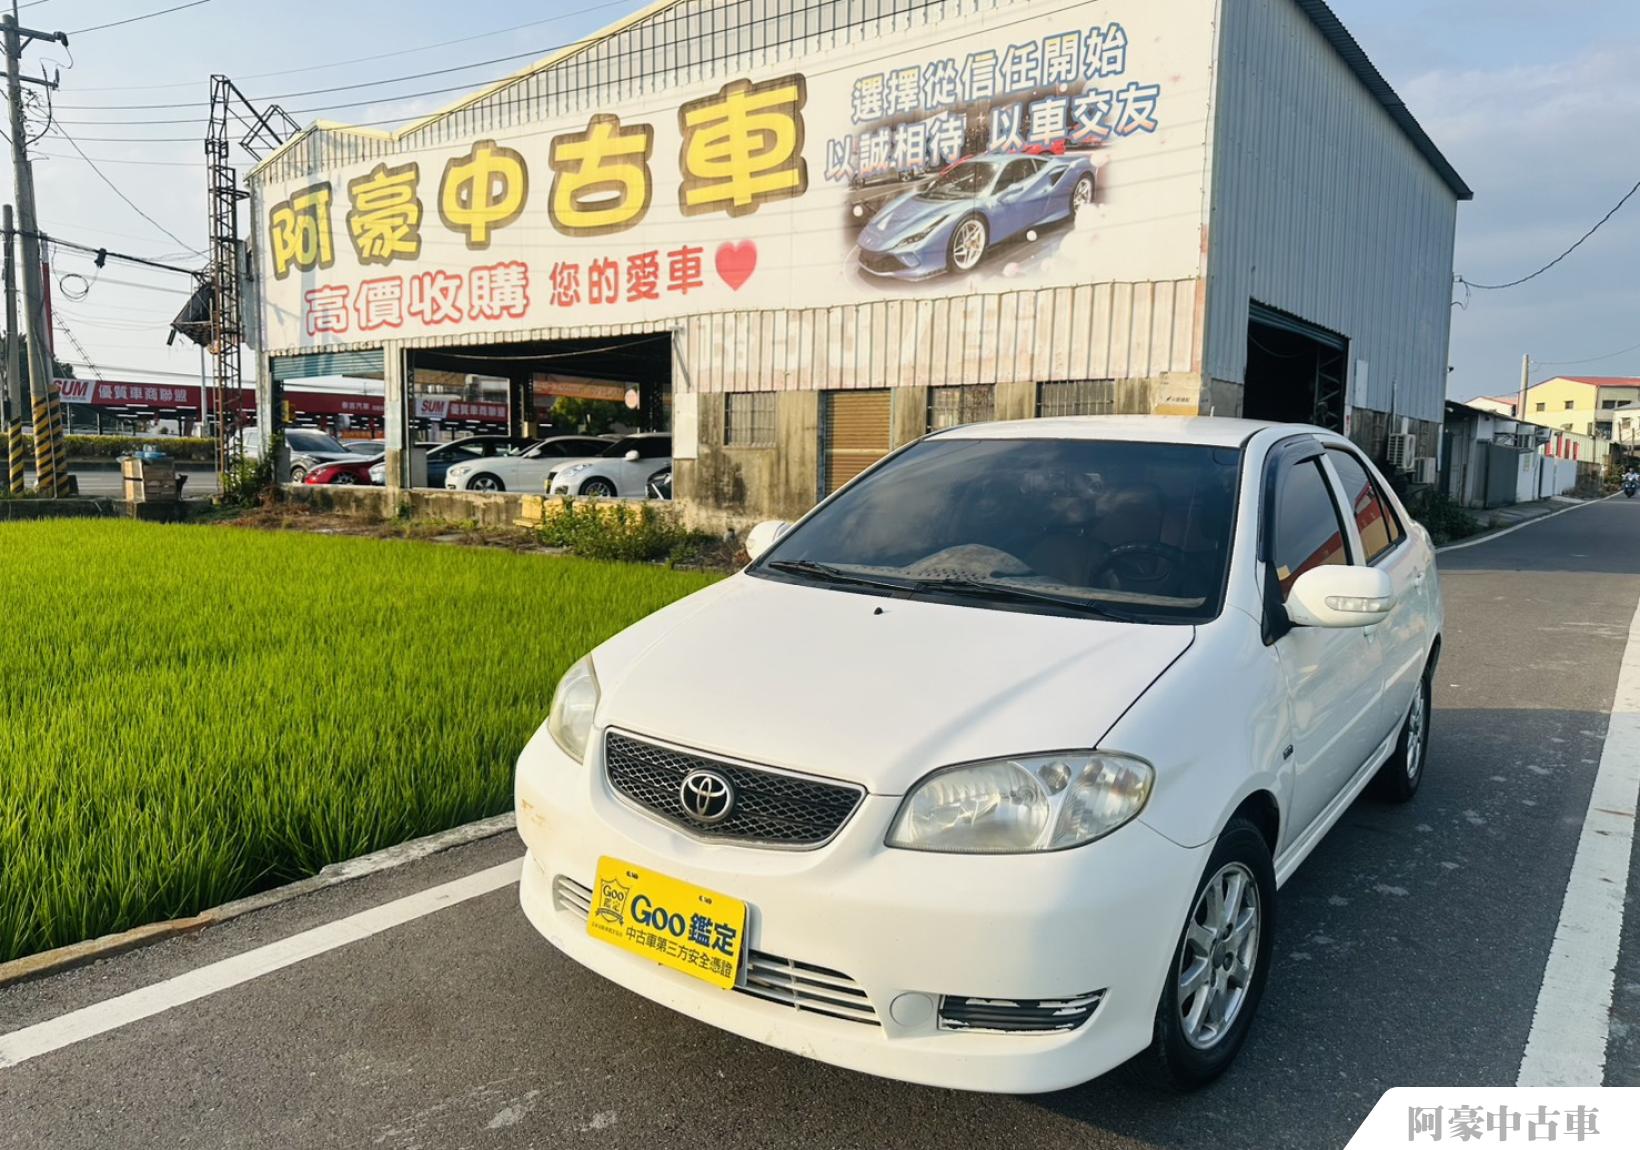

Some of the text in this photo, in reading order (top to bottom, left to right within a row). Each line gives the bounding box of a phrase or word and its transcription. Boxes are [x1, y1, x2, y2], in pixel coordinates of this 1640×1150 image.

[851, 23, 1128, 124] 選擇從信任開始
[270, 74, 808, 280] 阿豪中古車
[825, 83, 1160, 182] 以誠相待 以車交友
[306, 246, 704, 336] 高價收購 您的愛車
[421, 400, 445, 413] SUM
[631, 895, 737, 957] Goo 鑑定
